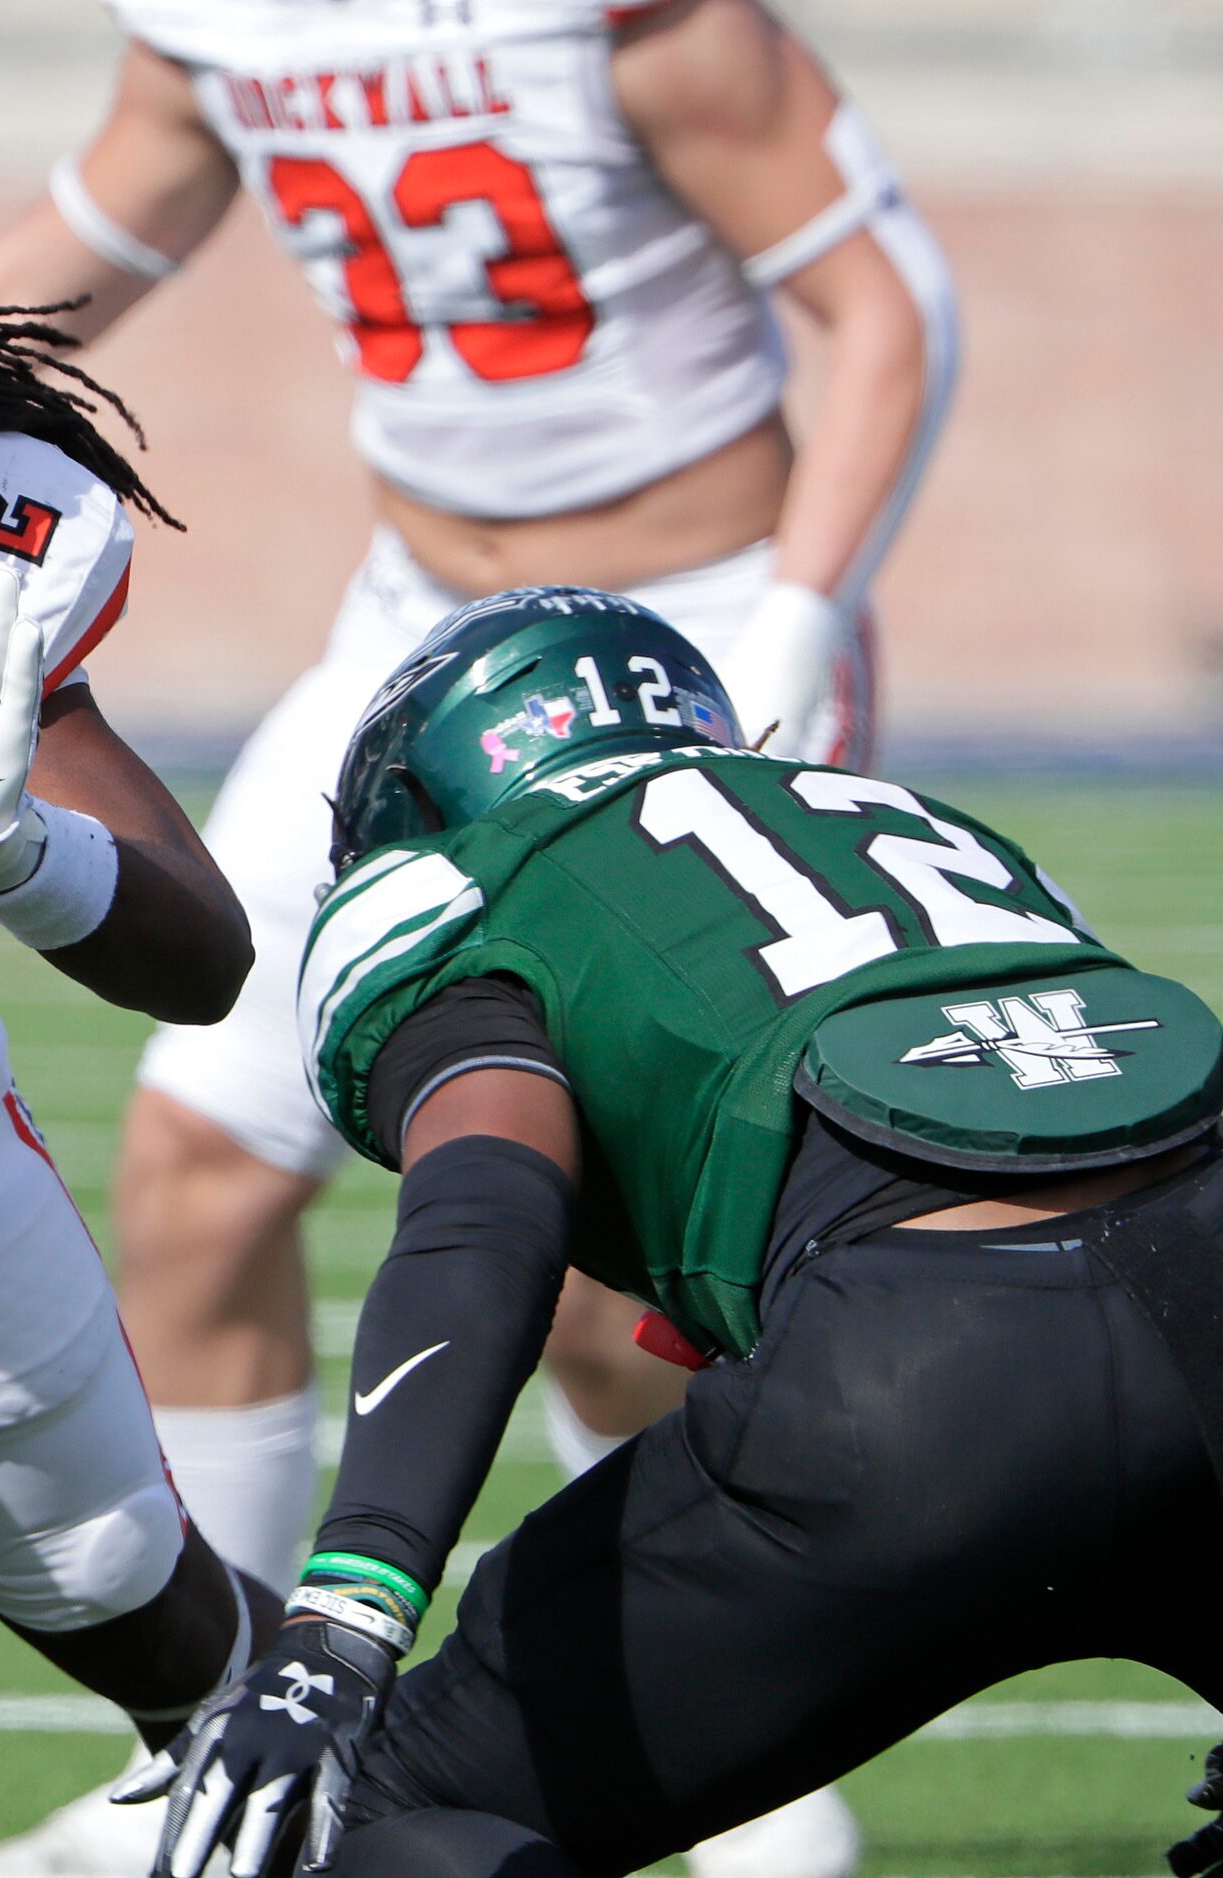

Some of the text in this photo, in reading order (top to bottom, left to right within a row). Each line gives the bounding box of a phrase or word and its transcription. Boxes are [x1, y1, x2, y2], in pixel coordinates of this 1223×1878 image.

[267, 138, 597, 386] 33
[574, 655, 683, 728] 12
[630, 766, 1092, 1008] 12
[940, 987, 1123, 1090] W
